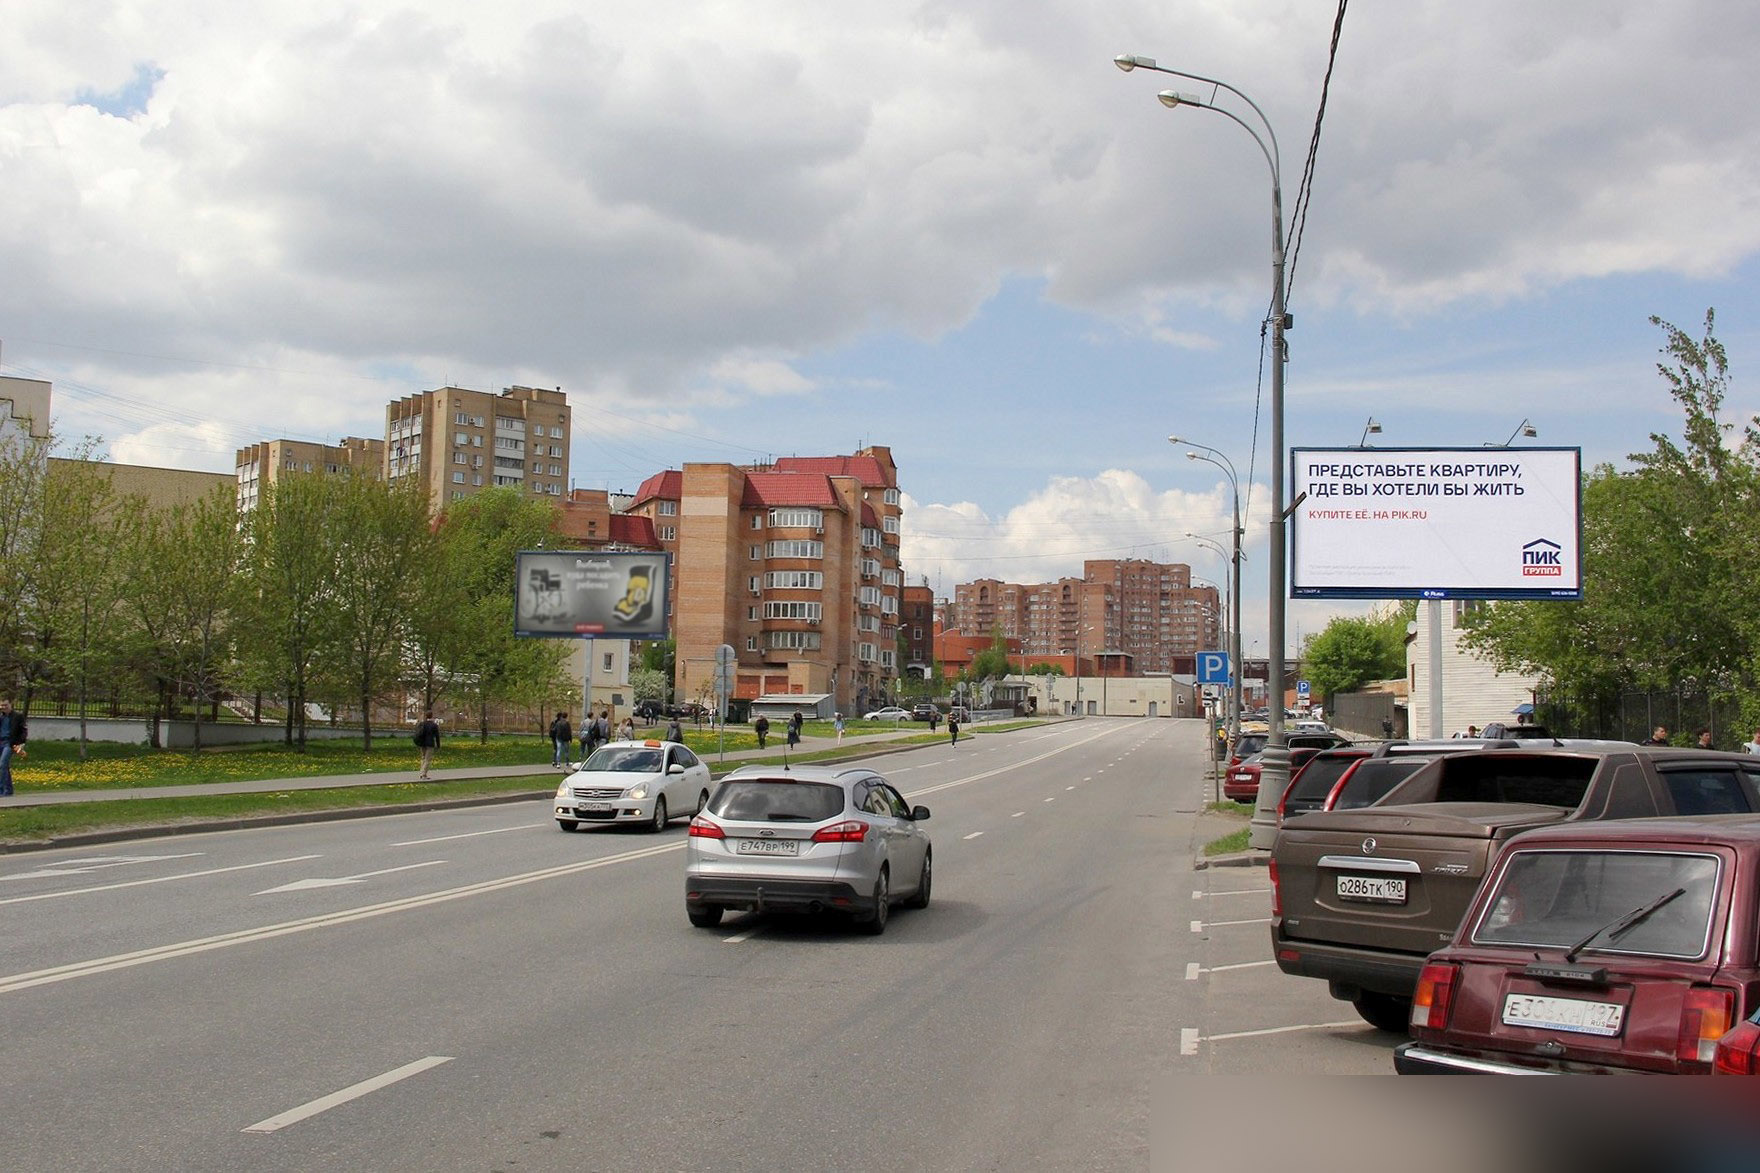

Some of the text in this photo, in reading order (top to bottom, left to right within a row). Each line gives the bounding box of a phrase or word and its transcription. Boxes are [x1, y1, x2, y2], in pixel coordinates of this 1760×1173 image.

[1309, 464, 1522, 479] ПРЕДСТАВЬТЕ КВАРТИРУ,
[1309, 483, 1525, 498] ГДЕ ВЫ ХОТЕЛИ БЫ ЖИТЬ
[1309, 508, 1427, 519] КУПИТЕ ЕЁ. НА PIK.RU
[1523, 551, 1561, 564] ПИК
[1524, 567, 1560, 575] ГРУППА
[1205, 655, 1223, 680] P
[1300, 682, 1308, 692] P
[1340, 878, 1402, 895] О286ТК 190
